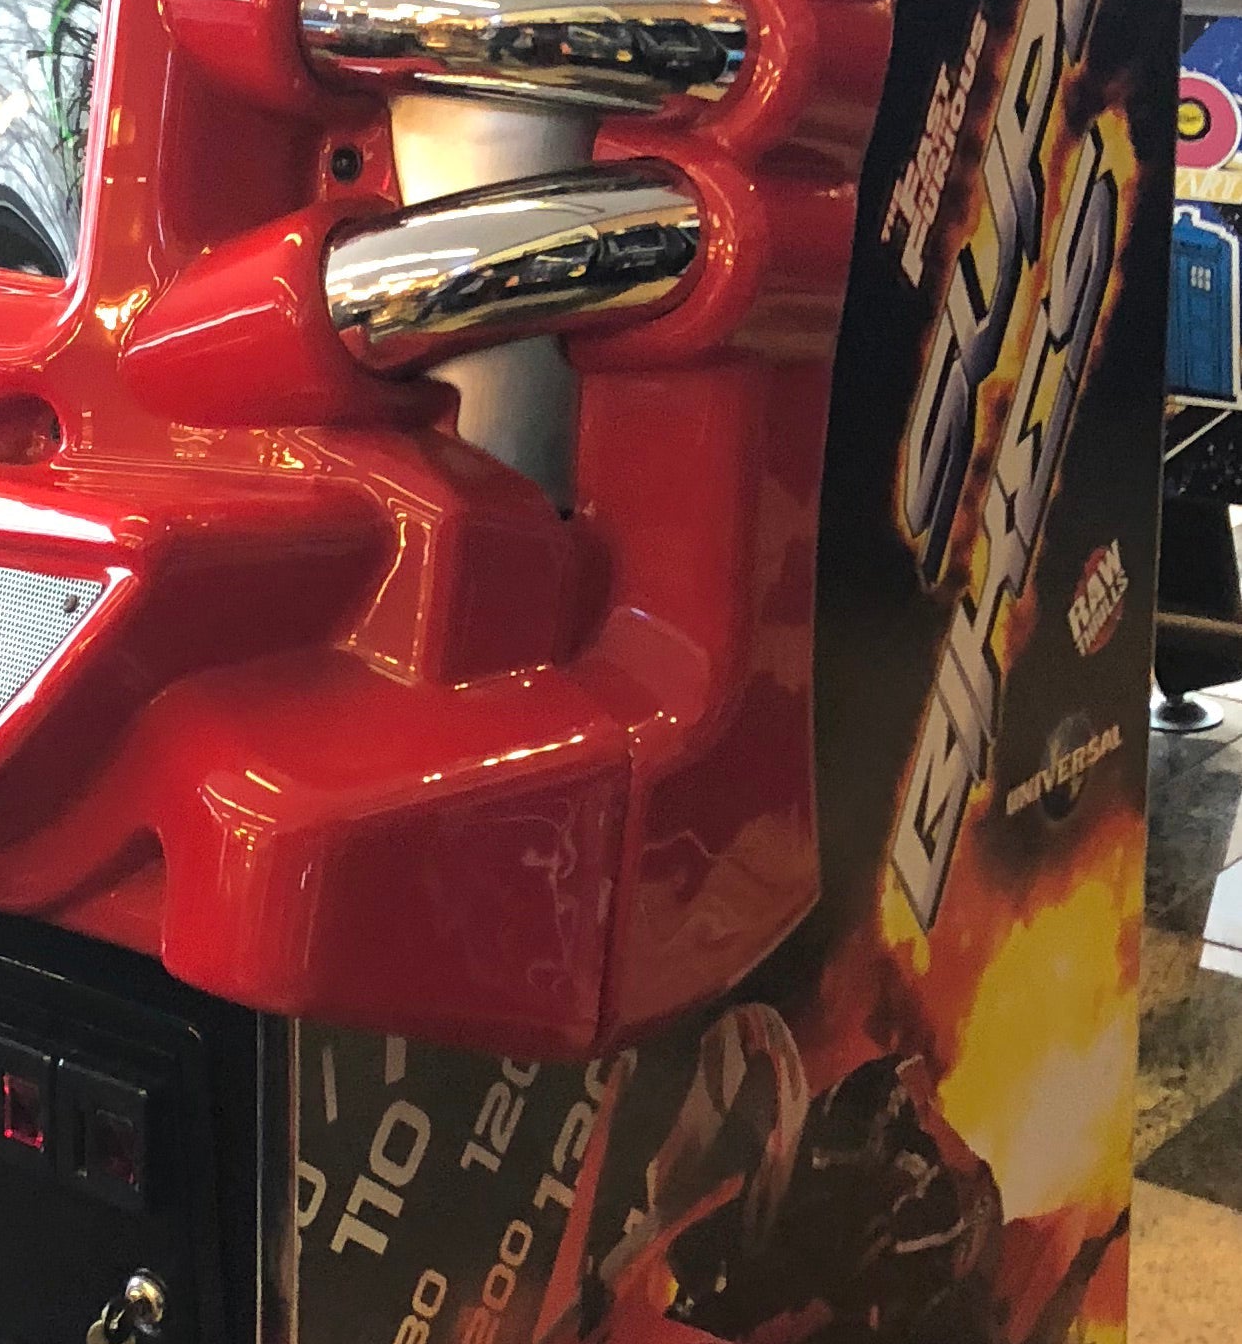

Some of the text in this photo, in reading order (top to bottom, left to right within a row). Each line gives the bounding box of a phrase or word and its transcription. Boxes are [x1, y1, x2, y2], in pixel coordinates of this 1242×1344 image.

[900, 59, 951, 226] FAST
[901, 2, 988, 289] FURIOUS
[891, 119, 1118, 933] BIKES
[1068, 538, 1123, 634] RAW
[1006, 724, 1123, 816] UNIVERSAL
[330, 1100, 432, 1256] 110
